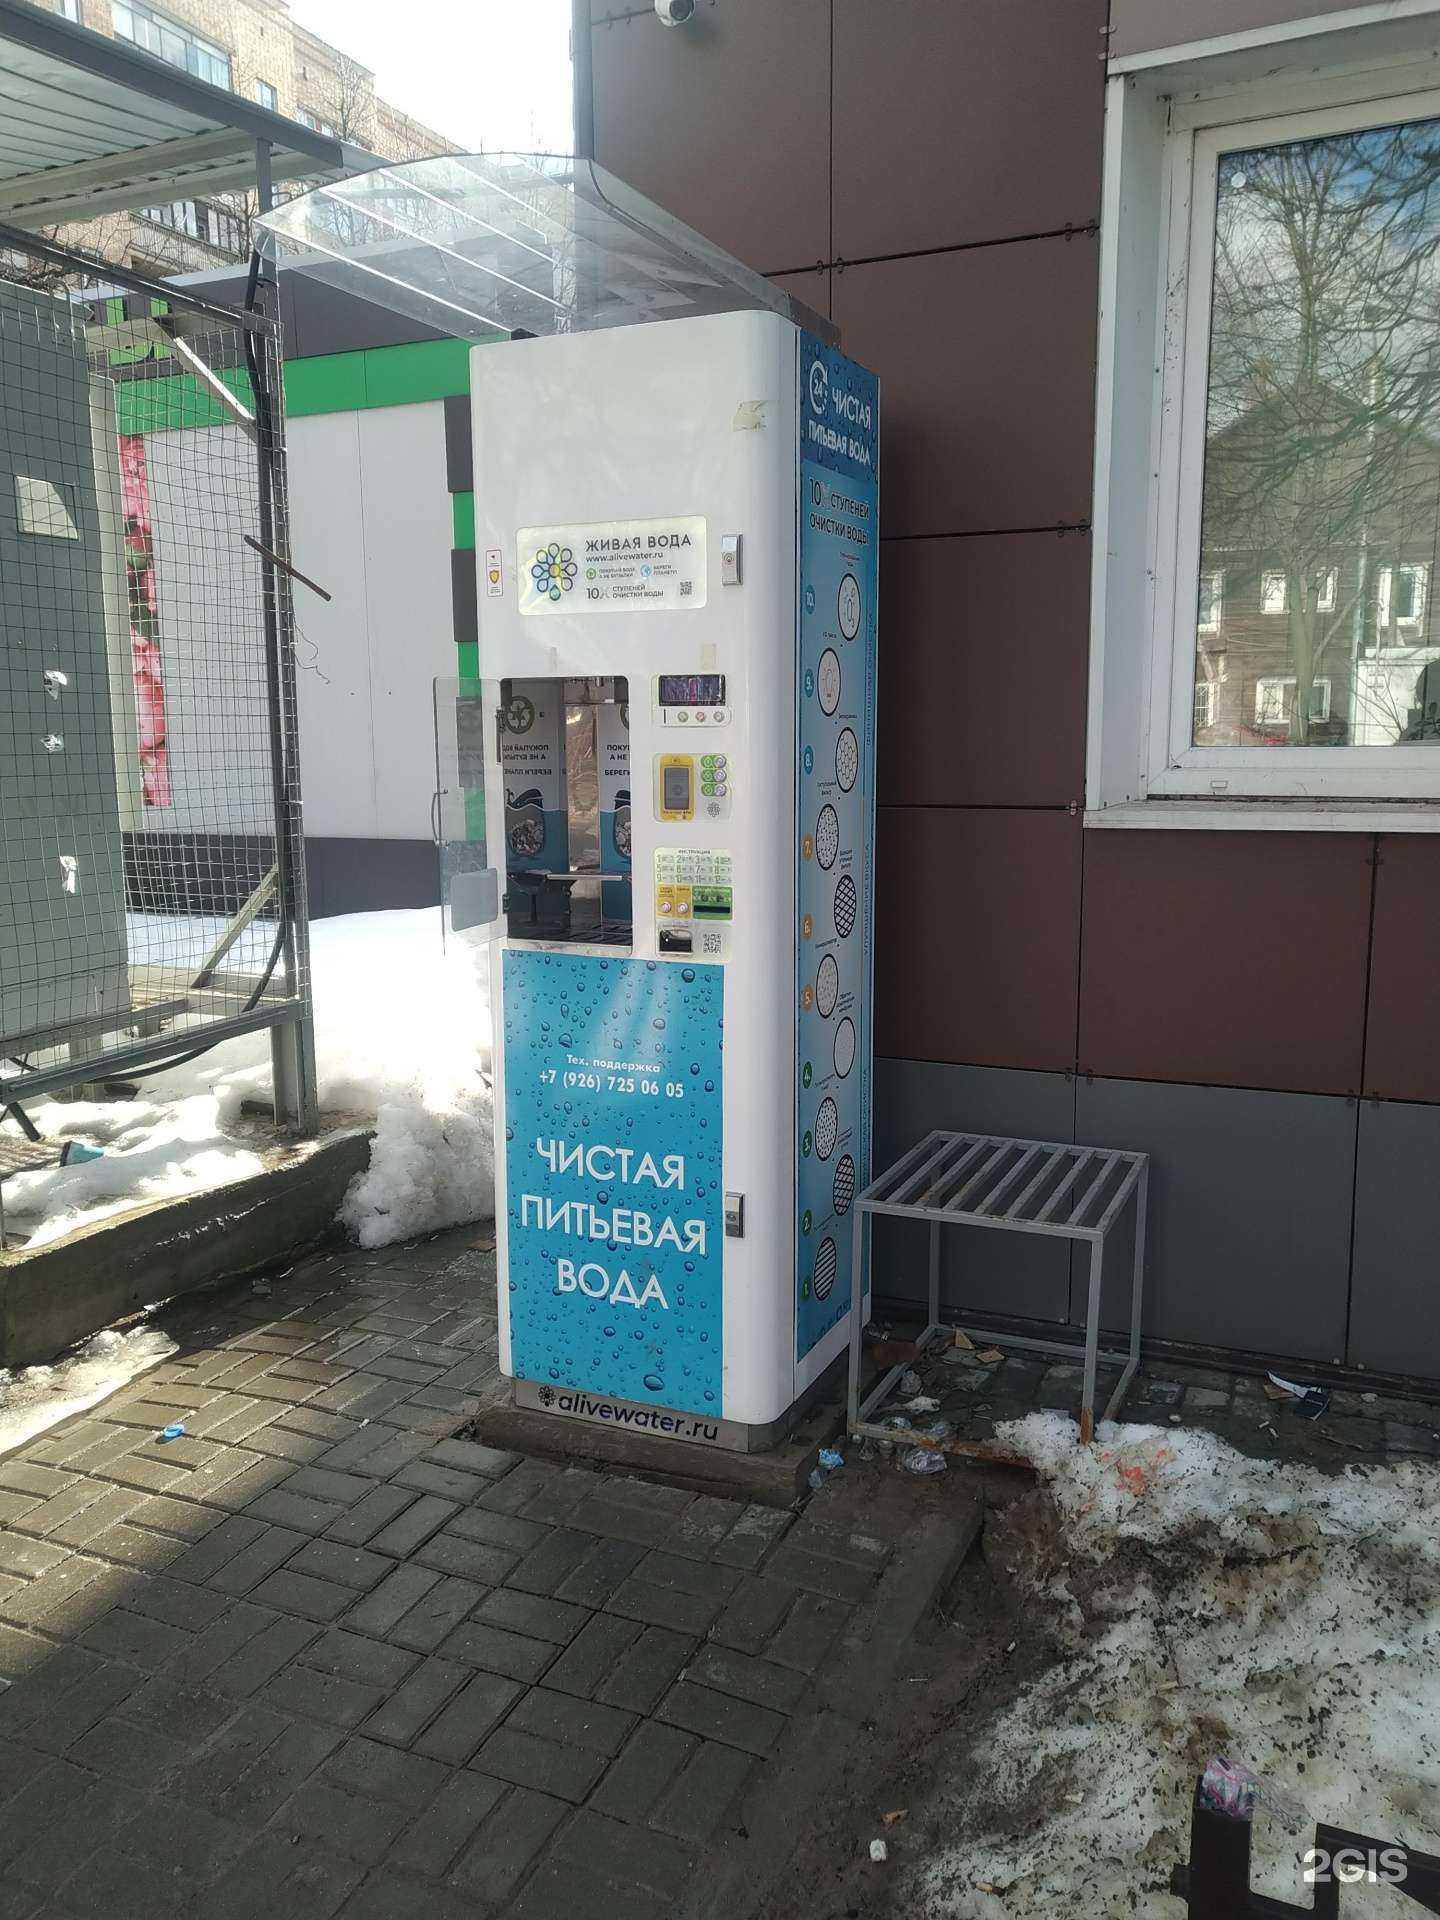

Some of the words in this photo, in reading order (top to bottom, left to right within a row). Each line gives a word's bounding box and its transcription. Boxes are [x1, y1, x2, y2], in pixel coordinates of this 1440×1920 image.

[813, 379, 823, 397] 24
[832, 387, 871, 430] ЧИСТАЯ
[809, 420, 848, 454] ПИТЬЕВАЯ
[849, 436, 870, 465] ВОДА
[809, 478, 821, 506] 10
[831, 493, 869, 520] СТУПЕНЕЙ
[586, 536, 641, 552] ЖИВАЯ
[648, 534, 691, 548] ВОДА
[810, 512, 846, 538] ОЧИСТКИ
[847, 522, 869, 545] ВОДЫ
[586, 551, 663, 562] www.alivewater.ru
[586, 587, 599, 599] 10
[613, 591, 643, 599] ОЧИСТКИ
[566, 1054, 589, 1066] Тех.
[593, 1059, 661, 1073] поддержка
[539, 1069, 556, 1084] +7
[563, 1071, 600, 1093] (926)
[607, 1077, 634, 1093] 725
[641, 1080, 659, 1096] 06
[665, 1082, 684, 1098] 05
[536, 1137, 684, 1190] ЧИСТАЯ
[521, 1194, 706, 1255] ПИТЬЕВАЯ
[557, 1258, 669, 1309] ВОДА
[558, 1394, 718, 1441] alivewater.ru
